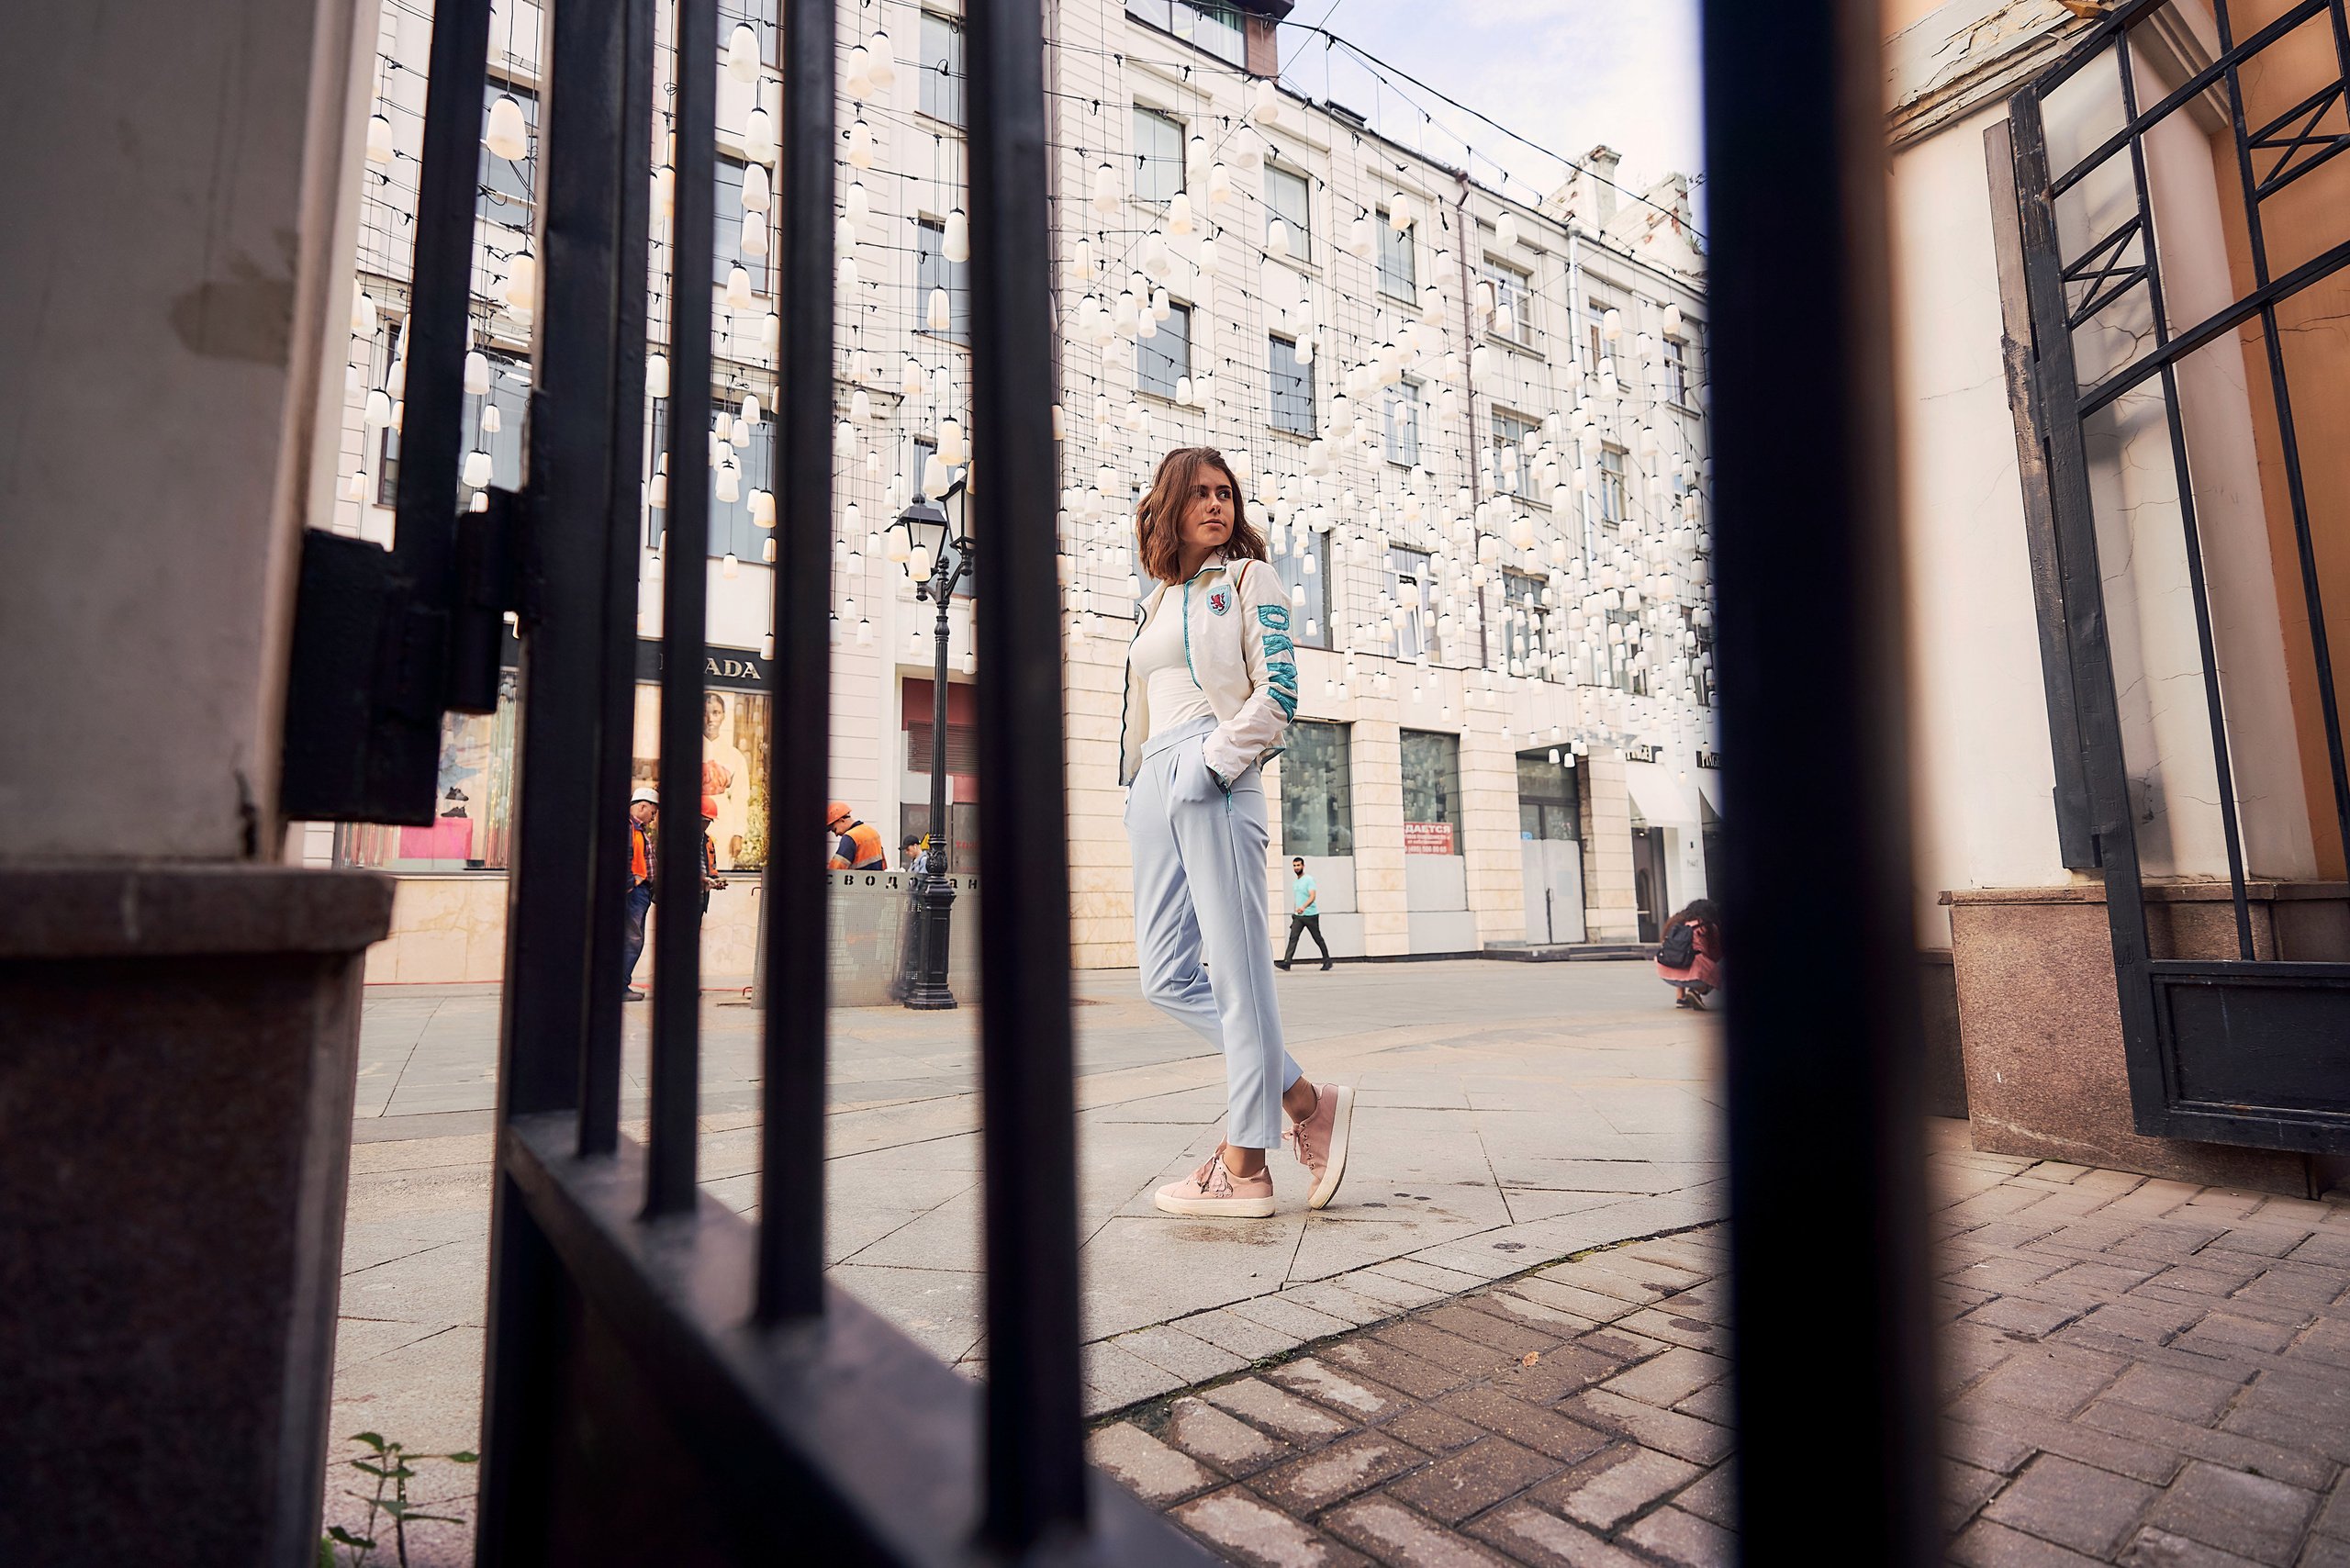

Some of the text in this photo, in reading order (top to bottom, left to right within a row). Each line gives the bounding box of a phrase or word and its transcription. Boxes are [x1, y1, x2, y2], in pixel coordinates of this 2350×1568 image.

[1257, 604, 1299, 723] DKNY
[1404, 824, 1450, 834] ДАЕТСЯ
[826, 874, 978, 889] сводоан
